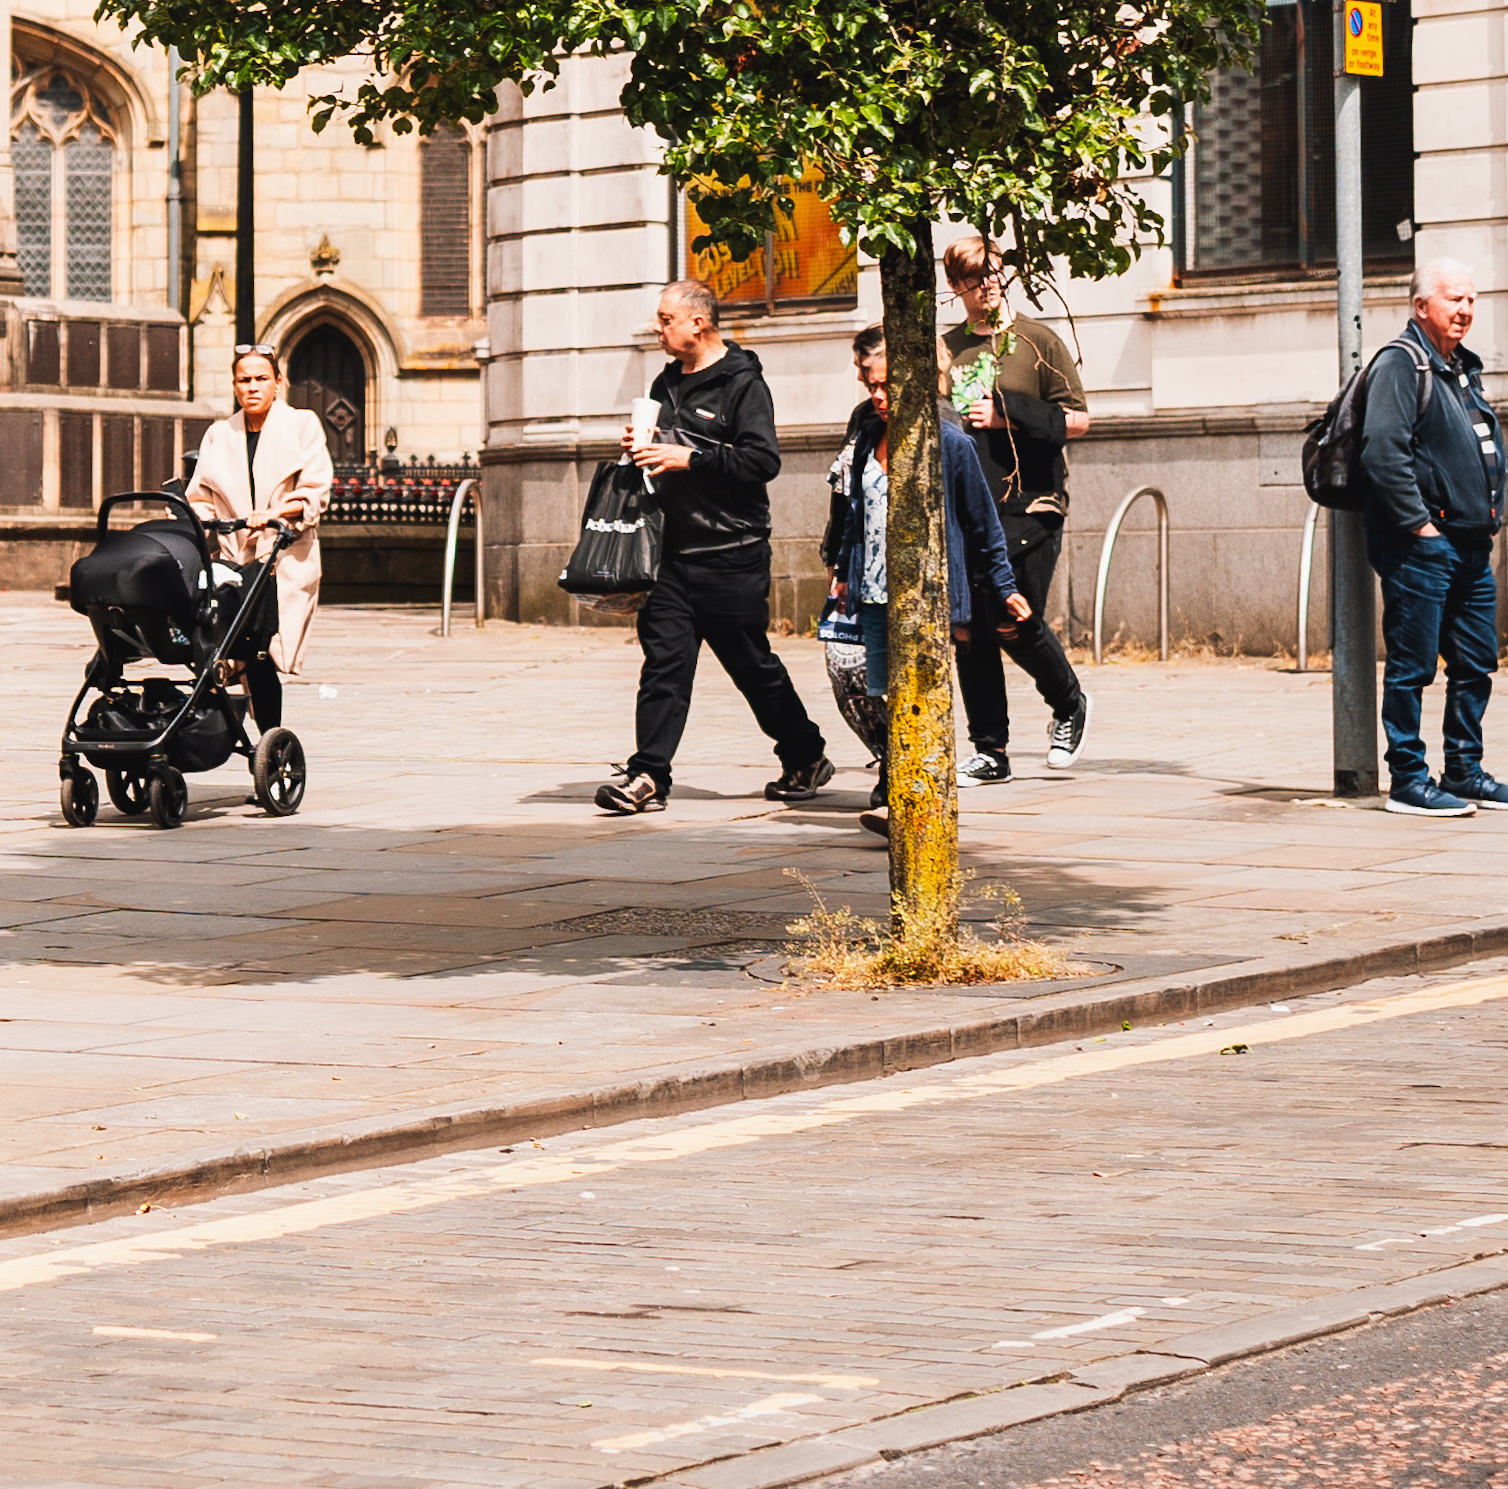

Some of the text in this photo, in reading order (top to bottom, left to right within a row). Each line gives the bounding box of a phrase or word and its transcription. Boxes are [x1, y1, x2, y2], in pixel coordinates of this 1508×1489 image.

[1369, 7, 1376, 18] At
[1367, 33, 1379, 43] time
[1360, 48, 1377, 59] verge
[1356, 59, 1381, 72] footway
